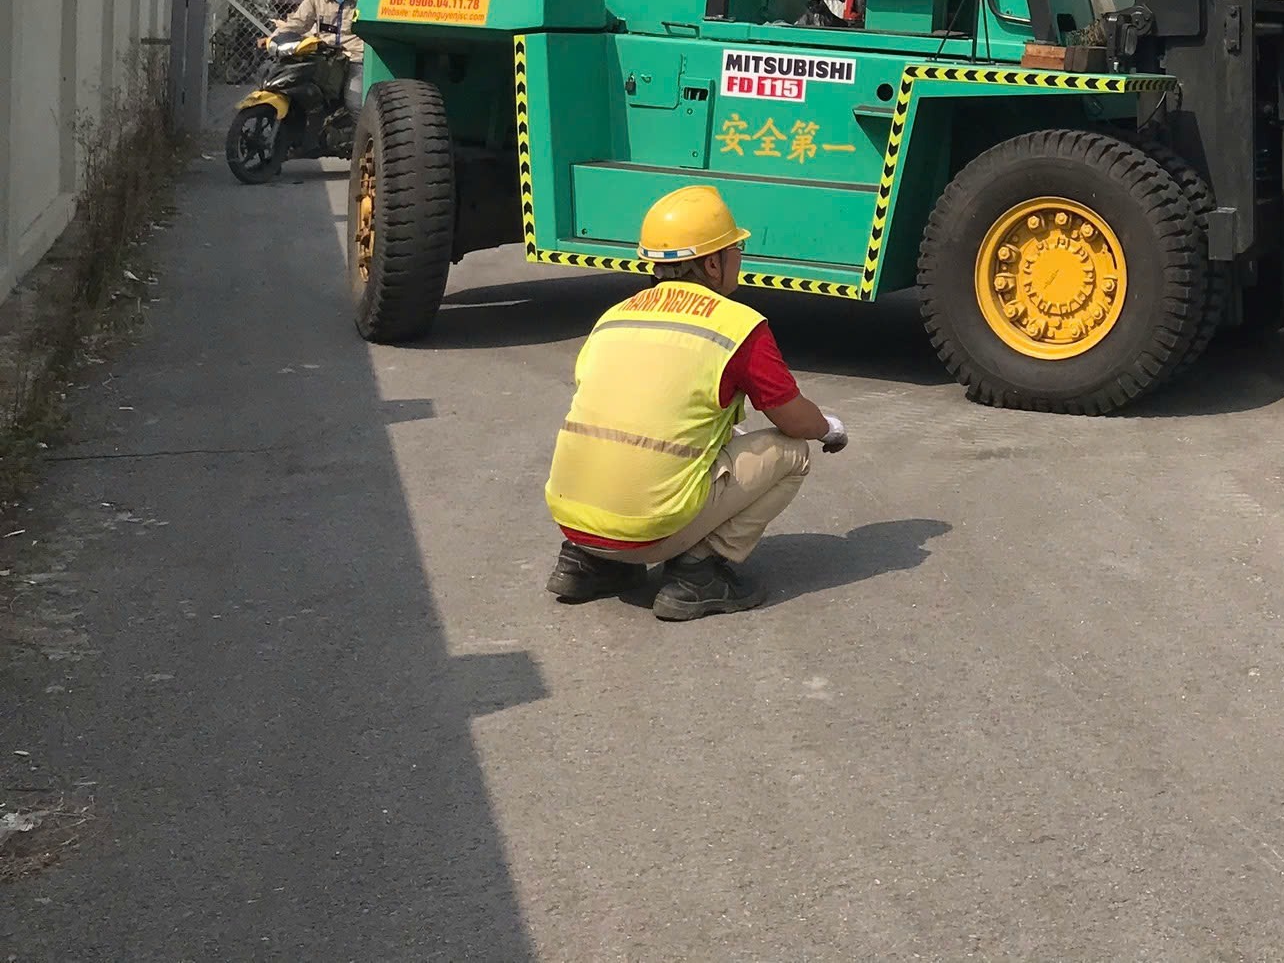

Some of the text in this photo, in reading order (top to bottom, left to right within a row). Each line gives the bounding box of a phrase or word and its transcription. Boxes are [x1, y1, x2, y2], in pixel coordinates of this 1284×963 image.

[725, 53, 853, 81] MITSUBISHI
[727, 76, 799, 98] FD 115
[715, 113, 856, 164] 安全第一
